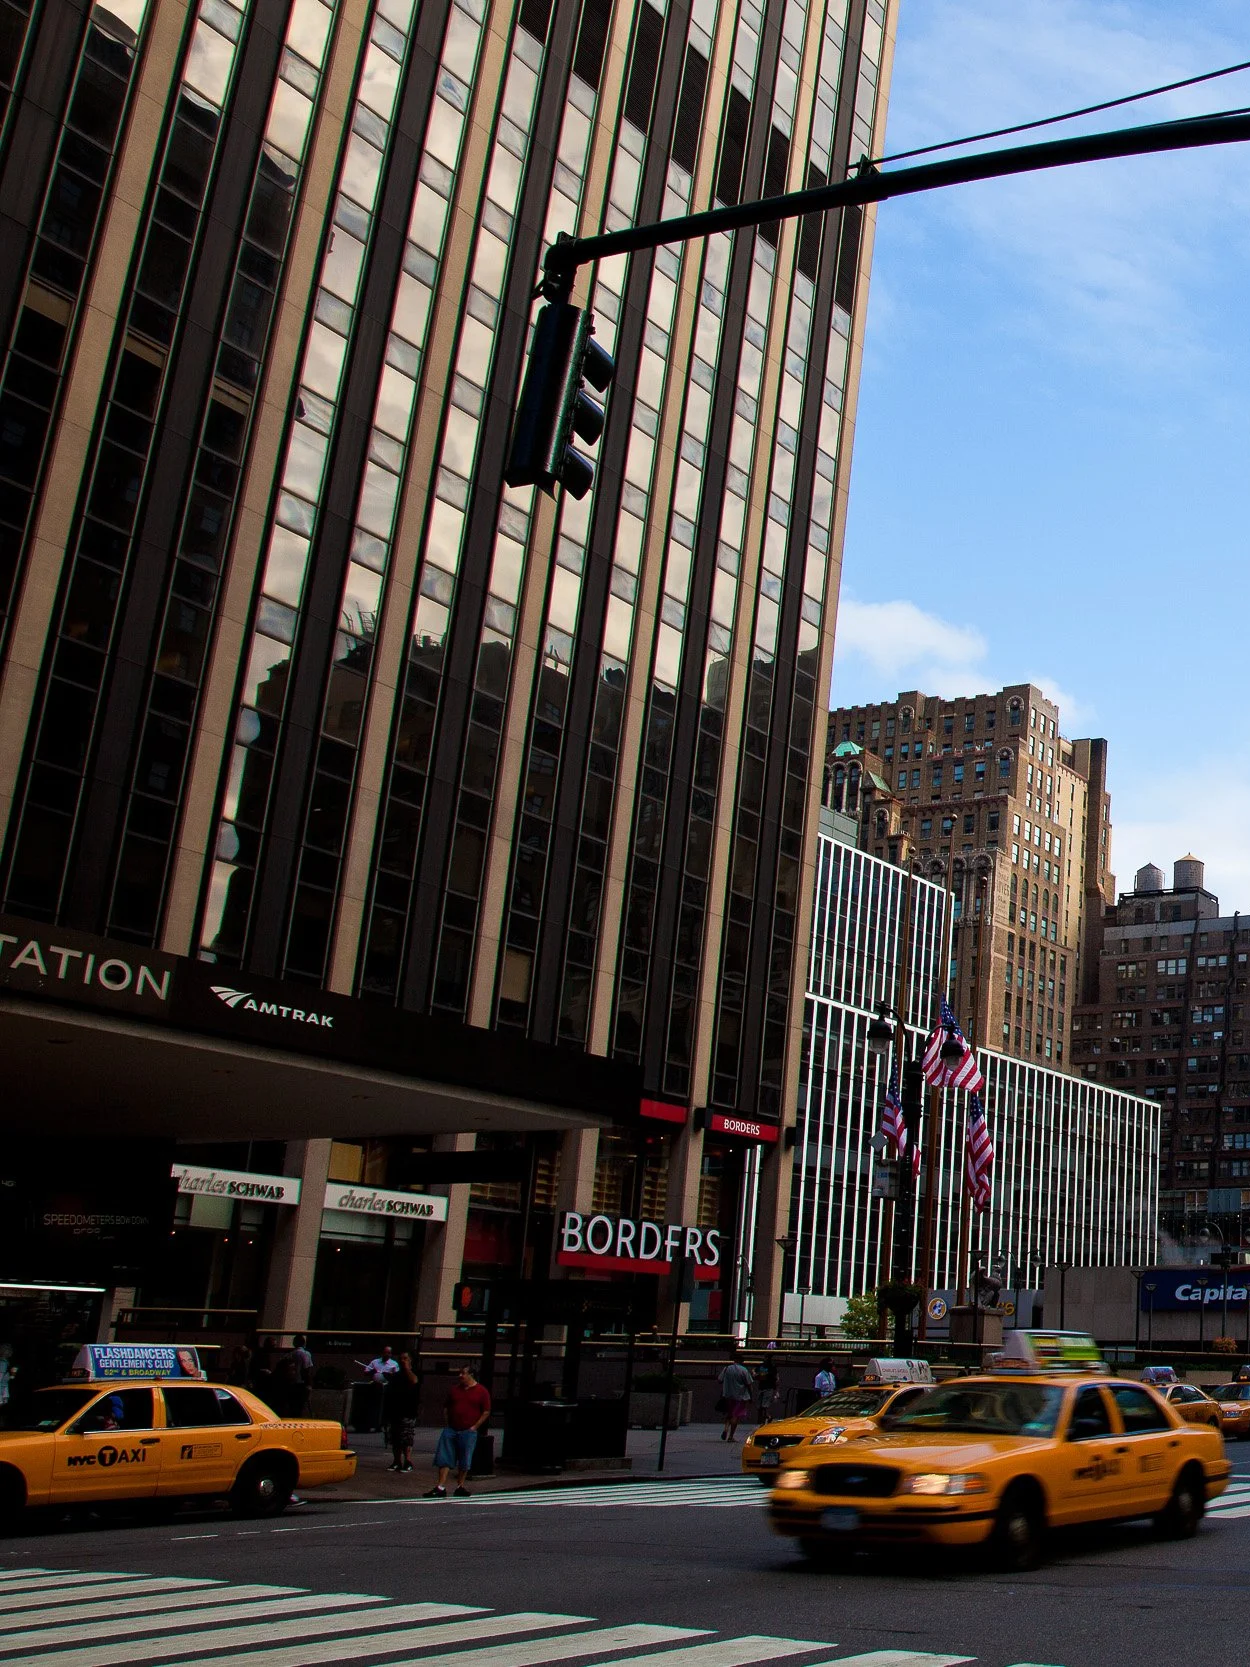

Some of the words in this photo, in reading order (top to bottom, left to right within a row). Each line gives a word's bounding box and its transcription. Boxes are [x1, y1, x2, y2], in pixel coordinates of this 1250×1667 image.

[244, 999, 334, 1028] AMTRAK
[724, 1119, 760, 1135] BORDERS
[228, 1181, 285, 1199] SCHWAB
[338, 1189, 387, 1211] charles
[387, 1200, 434, 1217] SCHWAB
[561, 1212, 720, 1266] BORDERS
[94, 1347, 175, 1359] FLASHDANCERS
[99, 1359, 153, 1368] GENTLEMEN'S
[154, 1359, 174, 1368] CLUB
[67, 1455, 96, 1466] NYC
[98, 1446, 146, 1466] TAXI
